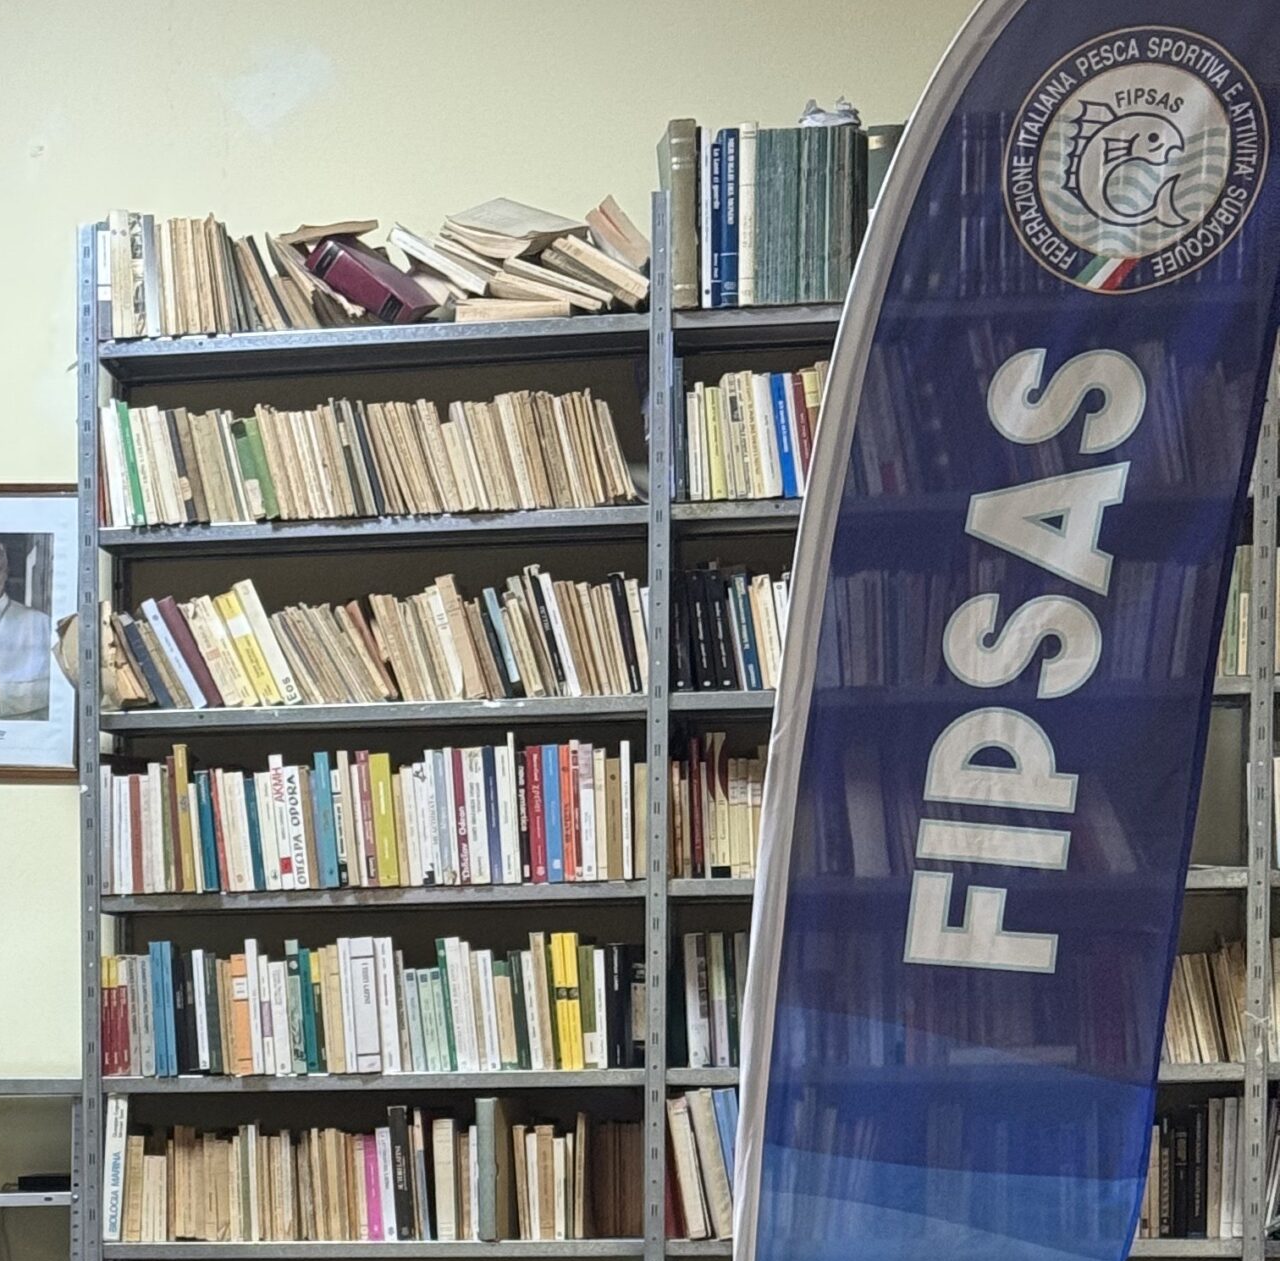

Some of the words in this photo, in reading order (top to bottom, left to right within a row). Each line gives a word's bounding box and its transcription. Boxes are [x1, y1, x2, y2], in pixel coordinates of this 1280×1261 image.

[1076, 41, 1140, 77] PESCA
[1147, 37, 1232, 92] SPORTIVA
[1017, 71, 1078, 152] ITALIANA
[1114, 87, 1185, 114] FIPSAS
[1011, 156, 1079, 271] FEDERAZIONE
[1153, 186, 1247, 278] SUBACQUEE
[903, 348, 1147, 974] FIPSAS
